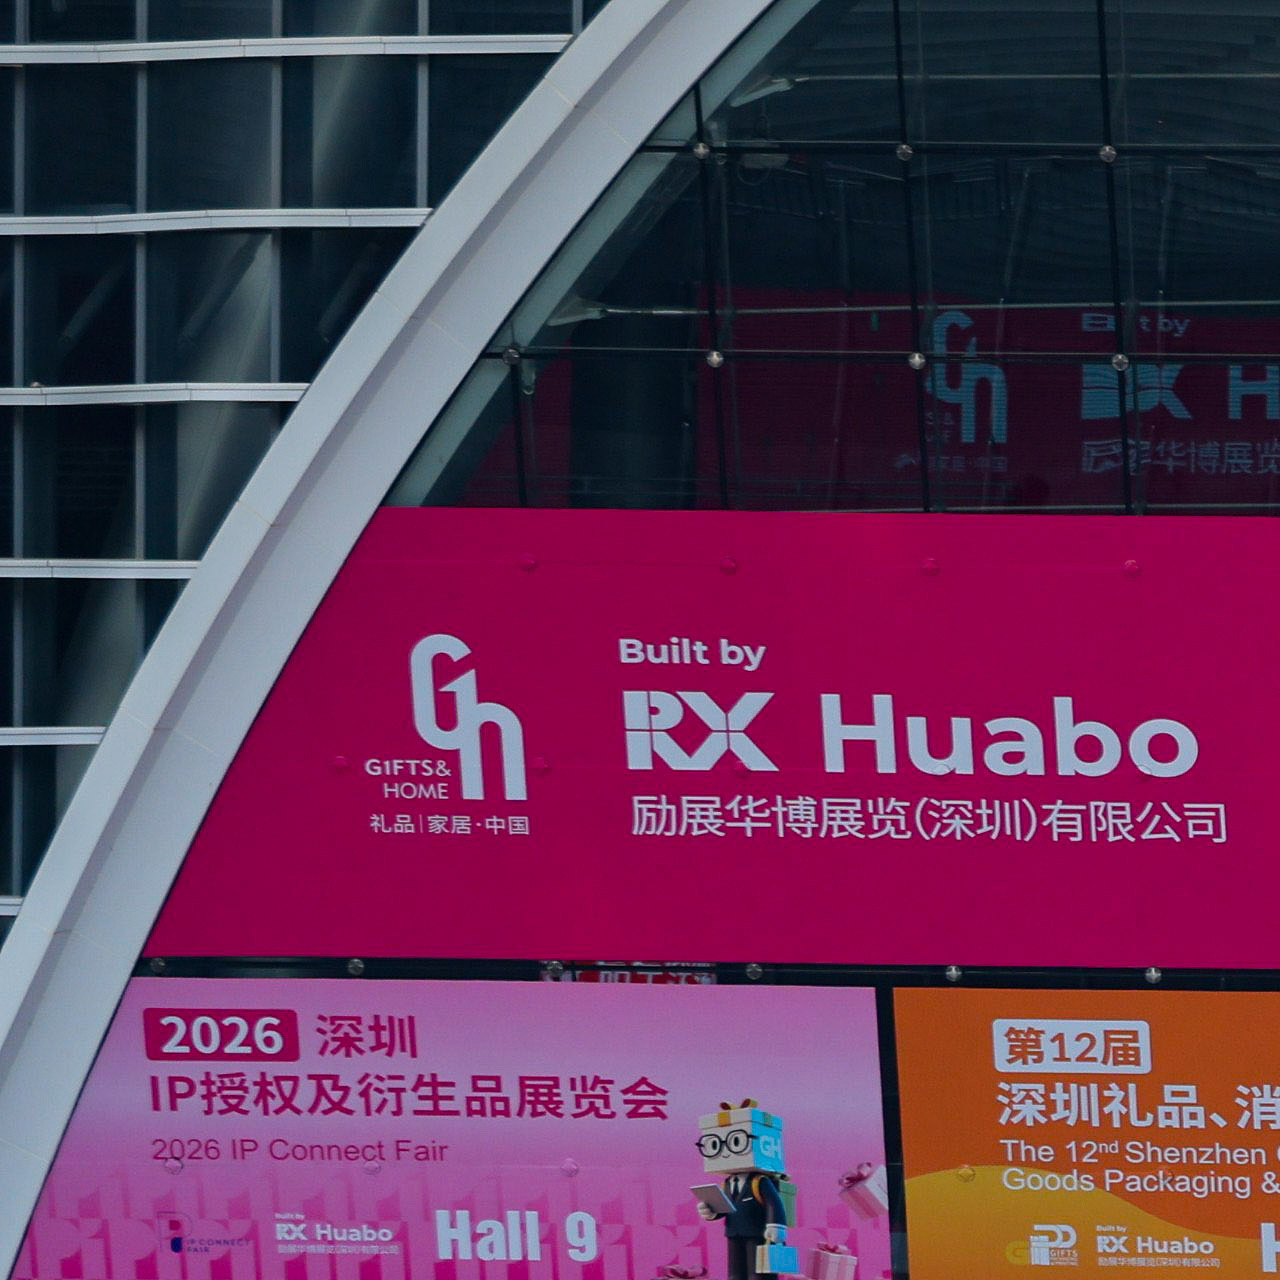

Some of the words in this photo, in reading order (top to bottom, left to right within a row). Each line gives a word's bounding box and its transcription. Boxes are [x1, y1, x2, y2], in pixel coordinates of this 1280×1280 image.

[619, 638, 710, 666] Built
[719, 640, 766, 671] by
[625, 690, 779, 772] RX
[820, 692, 1199, 778] Huabo
[383, 783, 448, 799] HOME
[632, 797, 1228, 845] 励展华博展览(深圳)有限公司
[160, 1015, 284, 1055] 2026
[315, 1013, 419, 1060] 深圳
[1003, 1026, 1141, 1068] 第12届
[150, 1072, 670, 1123] IP授权及衍生品展览会
[152, 1137, 220, 1163] 2026
[231, 1139, 260, 1162] IP
[271, 1137, 387, 1163] Connect
[396, 1139, 449, 1163] Fair
[1001, 1140, 1056, 1163] The
[1064, 1139, 1119, 1164] 12nd
[1125, 1141, 1269, 1165] Shenzhen
[1002, 1168, 1095, 1192] Goods
[1104, 1169, 1252, 1199] Packaging
[1261, 1171, 1280, 1193] &
[275, 1223, 307, 1241] RX
[316, 1223, 394, 1242] Huabo
[436, 1209, 541, 1262] Hall
[565, 1211, 599, 1264] 9
[1096, 1235, 1129, 1253] RX
[1136, 1236, 1215, 1254] Huabo
